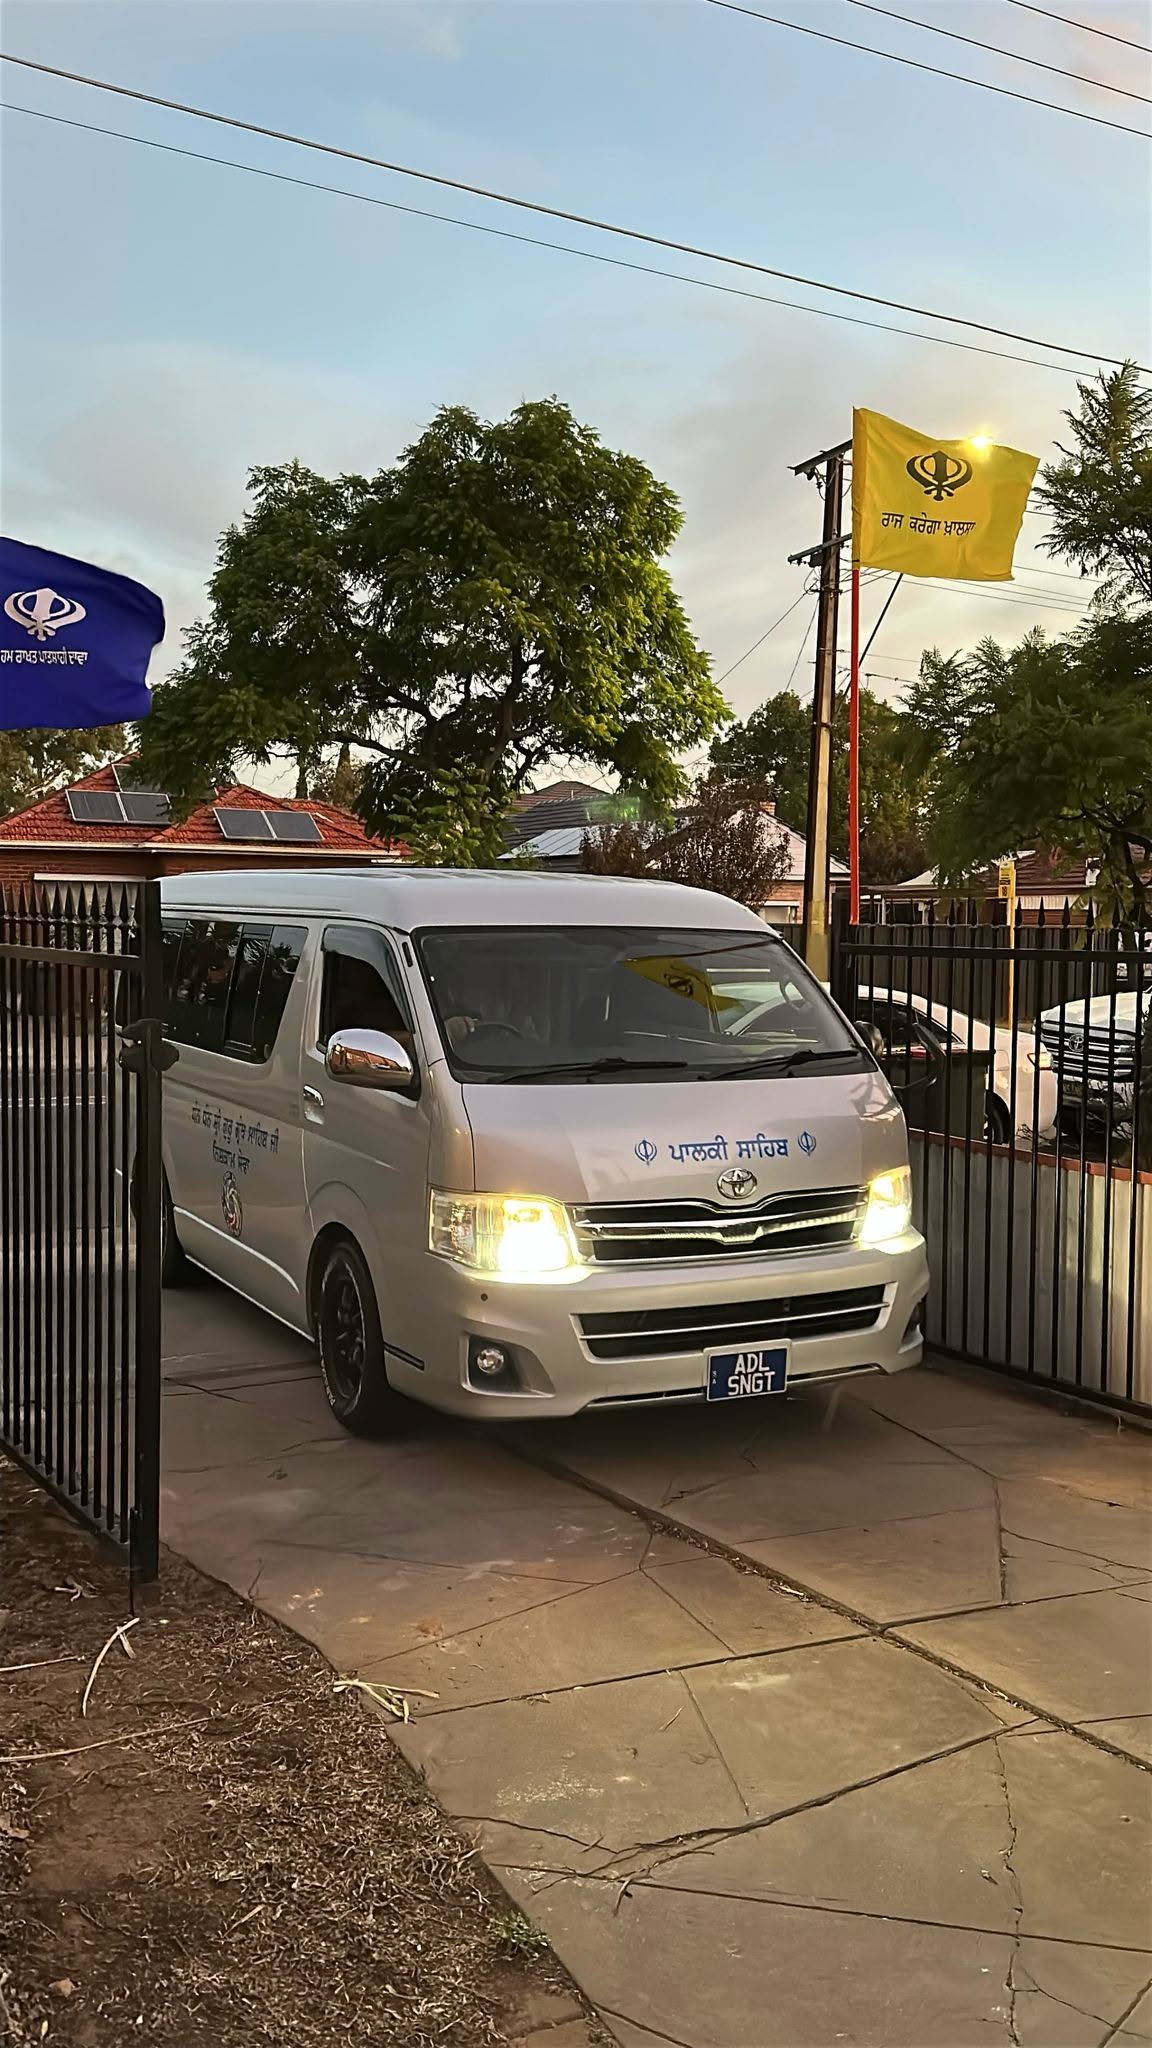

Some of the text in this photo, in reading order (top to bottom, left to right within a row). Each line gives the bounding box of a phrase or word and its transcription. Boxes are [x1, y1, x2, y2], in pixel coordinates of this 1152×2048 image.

[881, 512, 904, 529] ਰਾਜ
[909, 512, 942, 535] ਕਰੇਗਾ
[669, 1133, 789, 1163] ਪਾਲਕੀ ਸਾਹਿਬ
[734, 1352, 770, 1375] ADL
[727, 1371, 776, 1396] SNGT
